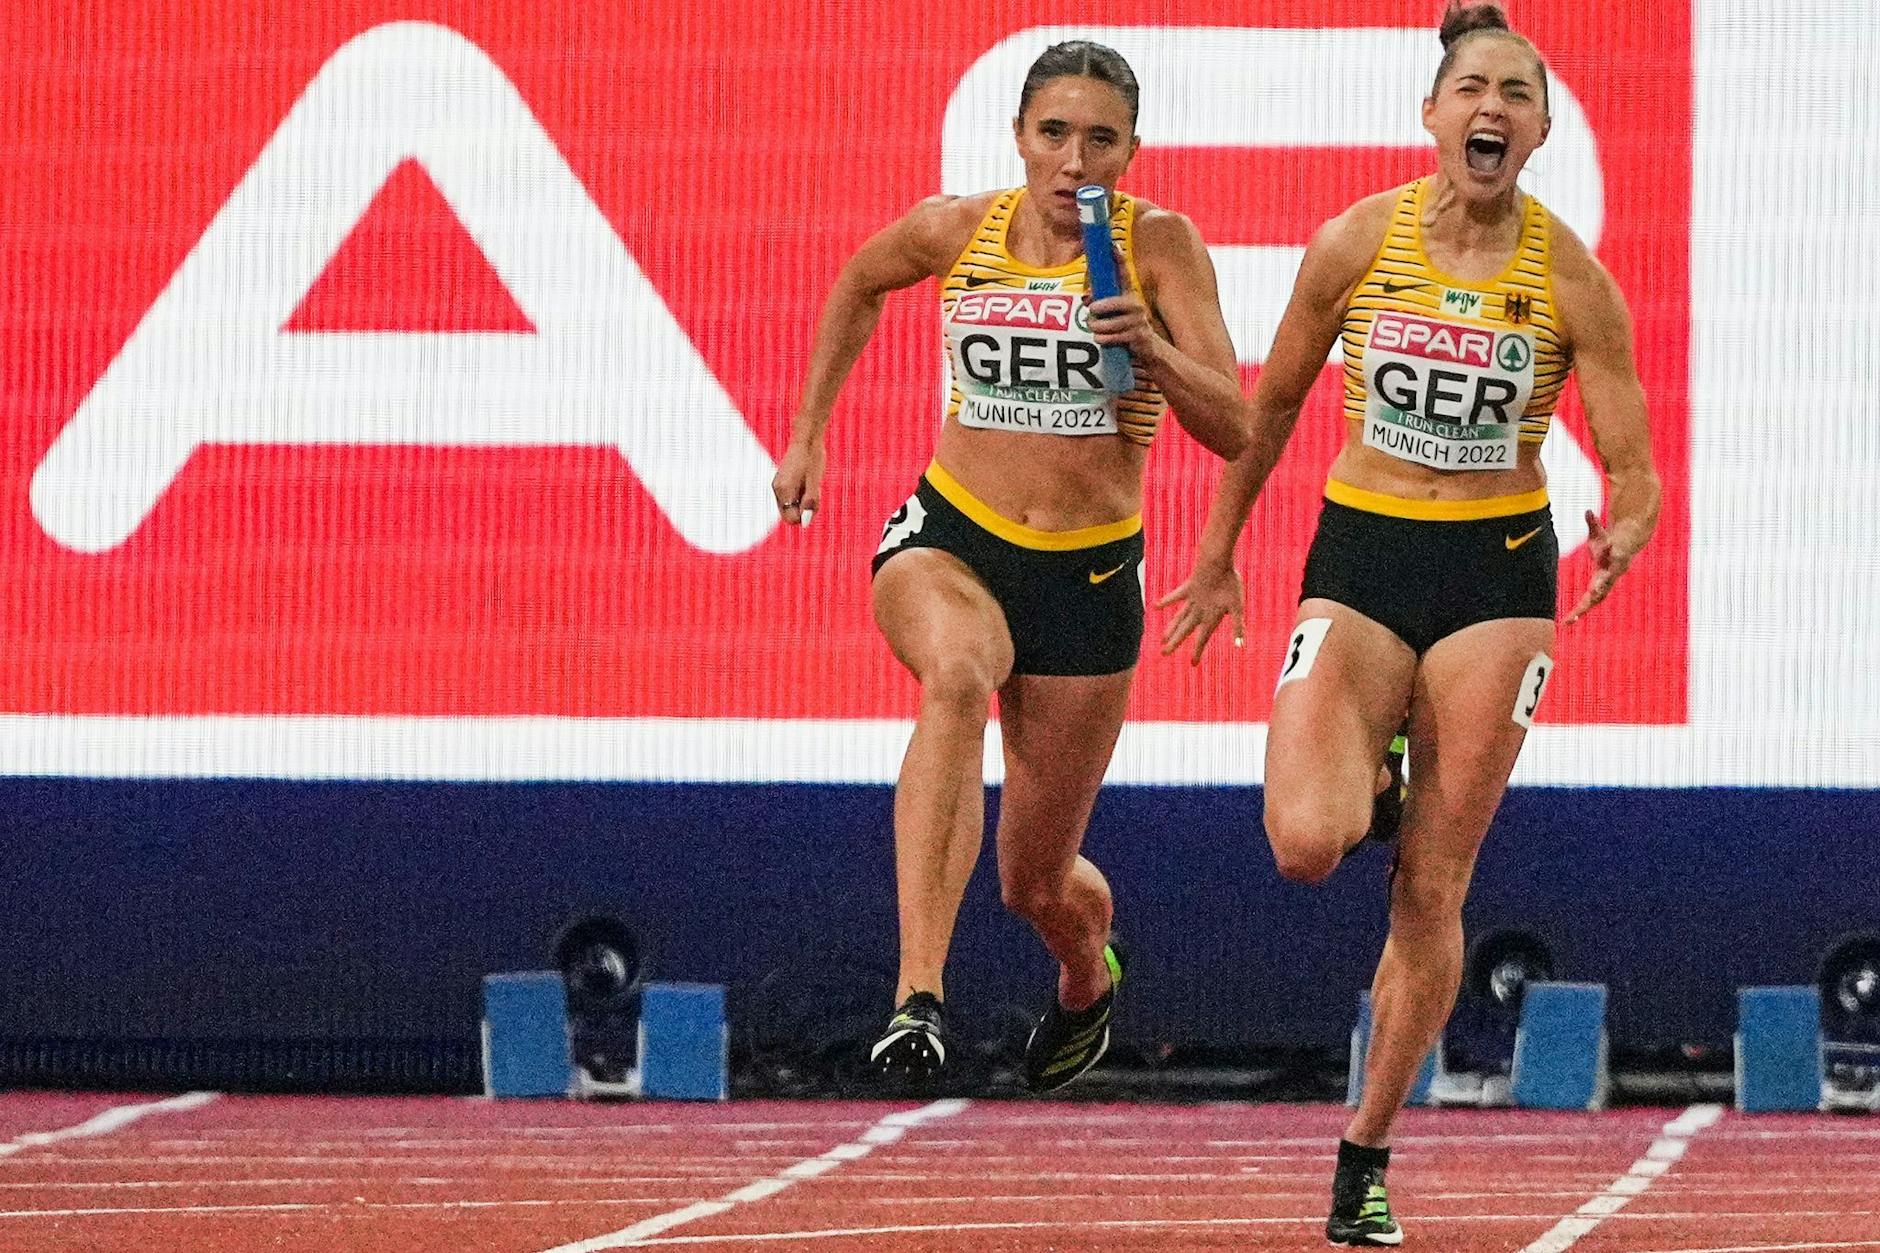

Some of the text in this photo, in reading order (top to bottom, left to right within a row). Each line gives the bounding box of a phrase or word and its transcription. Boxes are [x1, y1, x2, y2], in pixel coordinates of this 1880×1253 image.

[954, 297, 1067, 325] SPAR
[960, 333, 1104, 389] GER
[1374, 319, 1490, 363] SPAR
[964, 400, 1107, 428] MUNICH 2022
[1025, 389, 1073, 403] CLEAN
[1374, 361, 1518, 426] GER
[1398, 411, 1404, 424] I
[1405, 413, 1433, 433] RUN
[1371, 423, 1507, 464] MUNICH 2022
[1283, 633, 1304, 677] 3
[1525, 667, 1545, 717] 3
